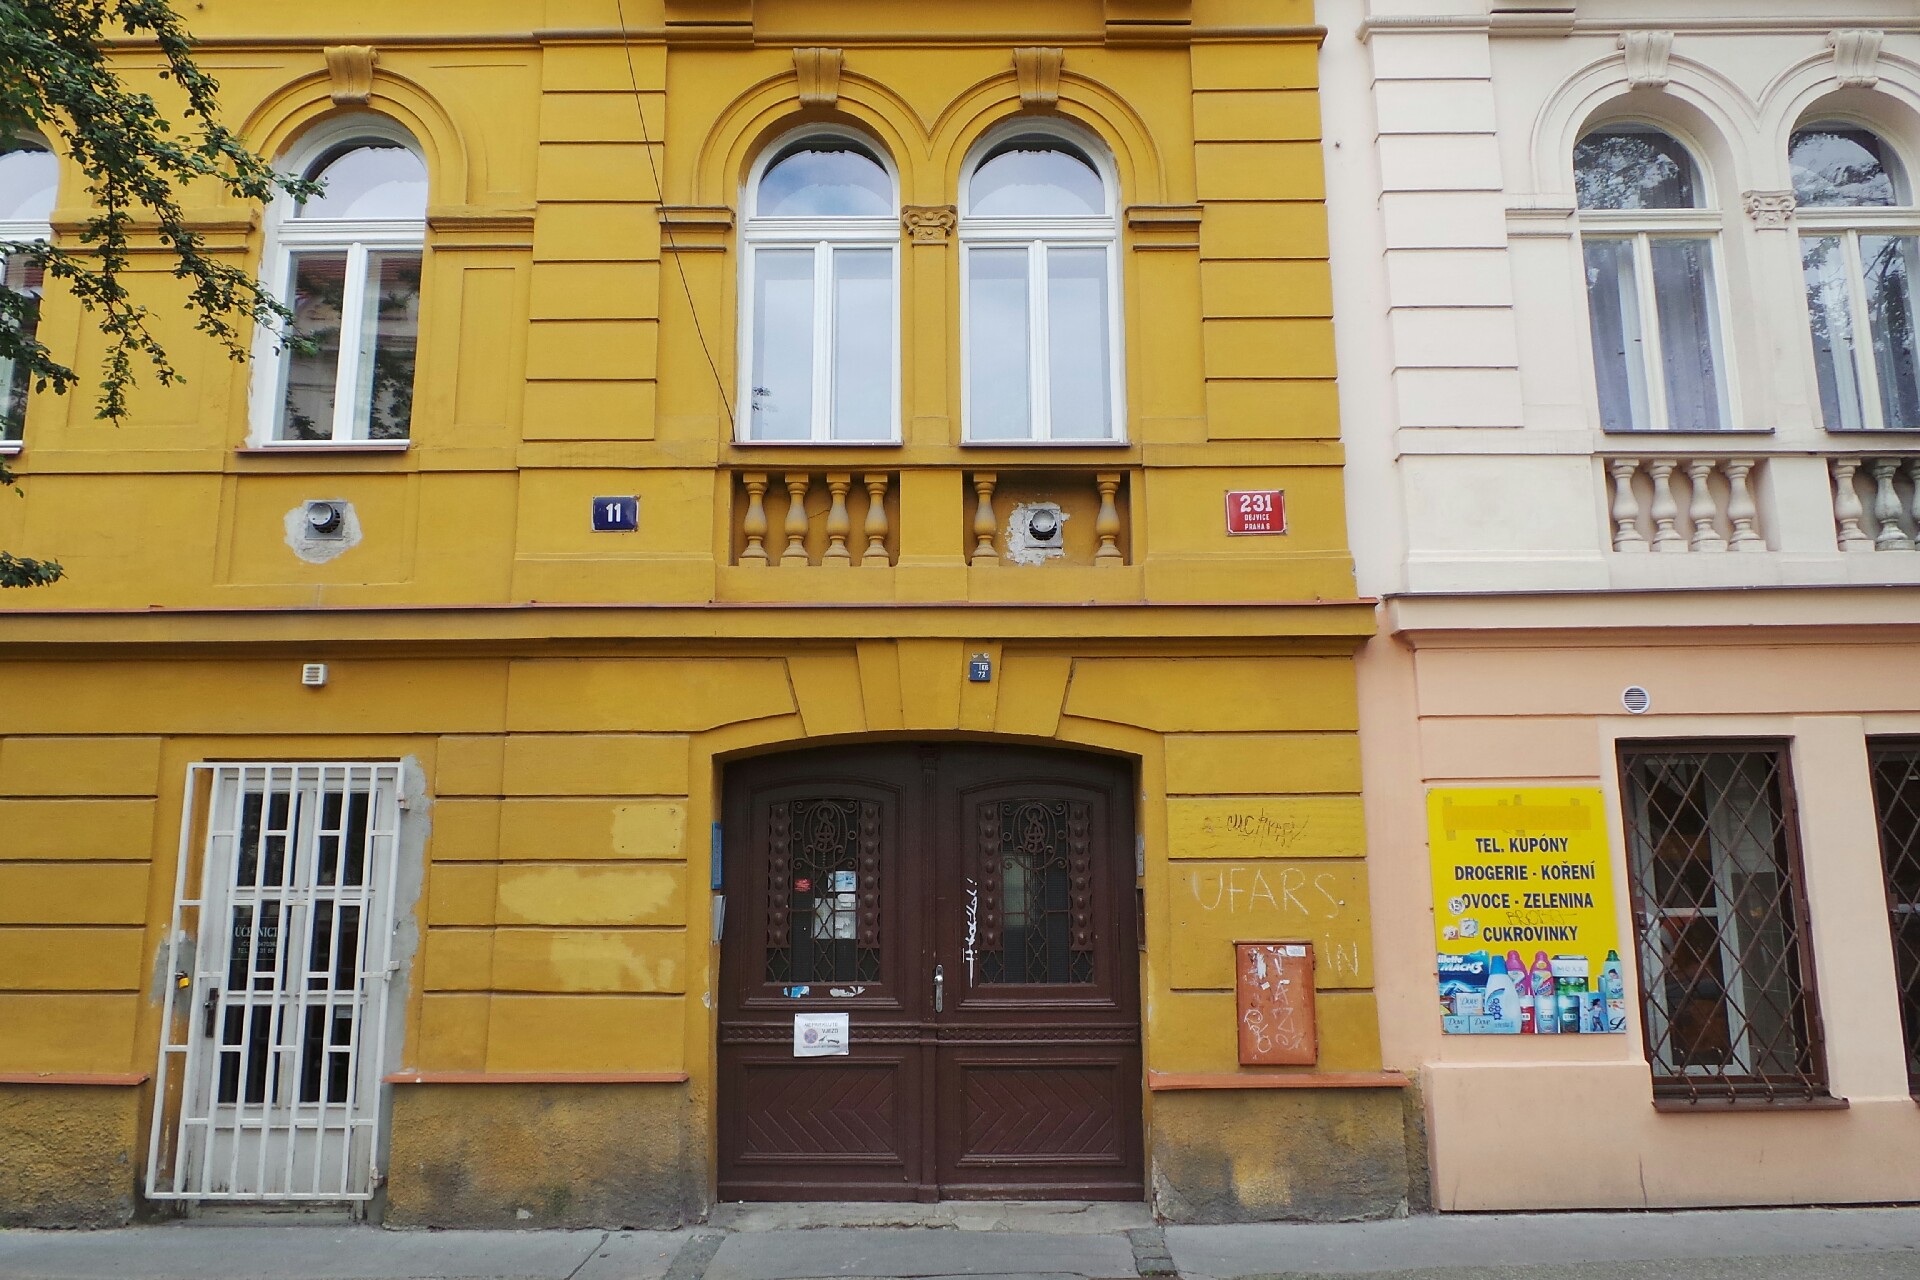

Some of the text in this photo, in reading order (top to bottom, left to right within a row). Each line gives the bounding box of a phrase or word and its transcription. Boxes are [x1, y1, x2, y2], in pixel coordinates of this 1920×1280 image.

[605, 503, 621, 523] 11
[1240, 494, 1272, 513] 231
[1244, 513, 1270, 521] DEJVICE
[1475, 833, 1568, 853] TEL. KUPÓNY
[1454, 865, 1528, 881] DROGERIE
[1541, 860, 1595, 880] KOŘENÍ
[1461, 893, 1511, 909] OVOCE
[1523, 892, 1594, 909] ZELENINA
[1483, 925, 1578, 942] CUKROVINKY
